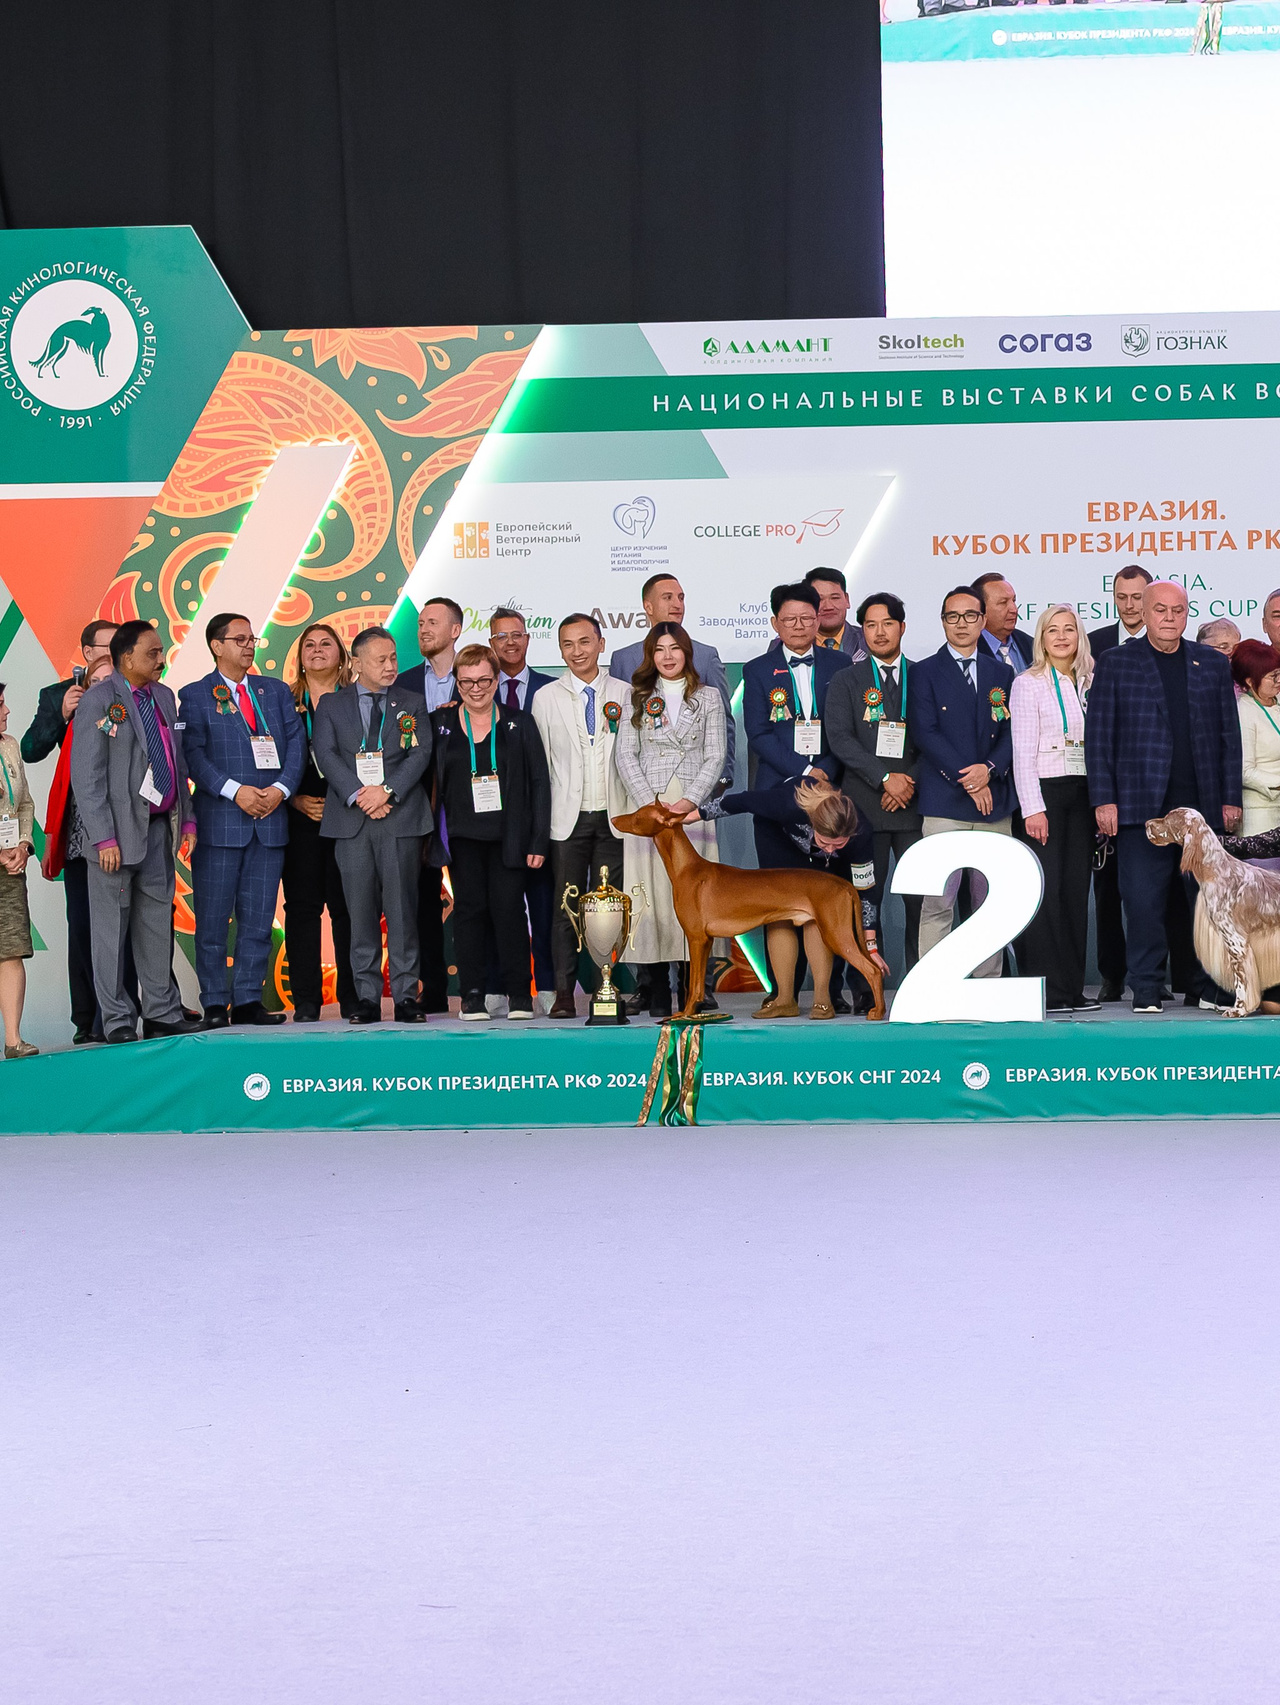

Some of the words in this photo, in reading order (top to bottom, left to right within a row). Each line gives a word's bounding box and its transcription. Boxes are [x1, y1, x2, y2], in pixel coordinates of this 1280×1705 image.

[8, 261, 150, 317] КИНОЛОГИЧЕСКАЯ
[109, 321, 157, 416] ФЕДЕРАЦИЯ
[725, 338, 833, 354] АДАМАНТ
[878, 334, 964, 350] Skoltech
[1157, 335, 1228, 350] ГОЗНАК
[653, 389, 923, 414] НАЦИОНАЛЬНЫЕ
[942, 385, 1113, 407] ВЫСТАВКИ
[1131, 382, 1237, 402] СОБАК
[60, 415, 93, 429] 1991
[1087, 499, 1226, 522] ЕВРАЗИЯ.
[496, 521, 573, 533] Европейский
[693, 524, 761, 538] COLLEGE
[765, 524, 797, 537] PRO
[496, 533, 581, 545] Ветеринарный
[932, 533, 1031, 556] КУБОК
[1040, 529, 1238, 556] ПРЕЗИДЕНТА
[496, 547, 531, 557] Центр
[740, 602, 768, 614] Клуб
[1209, 599, 1258, 617] CUP
[462, 606, 556, 634] Chion
[699, 616, 768, 627] Заводчиков
[735, 629, 768, 638] Валта
[889, 830, 1046, 1023] 2
[703, 1071, 788, 1087] ЕВРАЗИЯ.
[793, 1070, 854, 1086] КУБОК
[860, 1069, 895, 1084] СНГ
[900, 1069, 941, 1084] 2024
[1005, 1067, 1091, 1083] ЕВРАЗИЯ.
[1097, 1066, 1158, 1081] КУБОК
[283, 1077, 368, 1094] ЕВРАЗИЯ.
[372, 1076, 433, 1092] КУБОК
[438, 1075, 560, 1092] ПРЕЗИДЕНТА
[564, 1074, 602, 1089] РКФ
[606, 1073, 648, 1088] 2024
